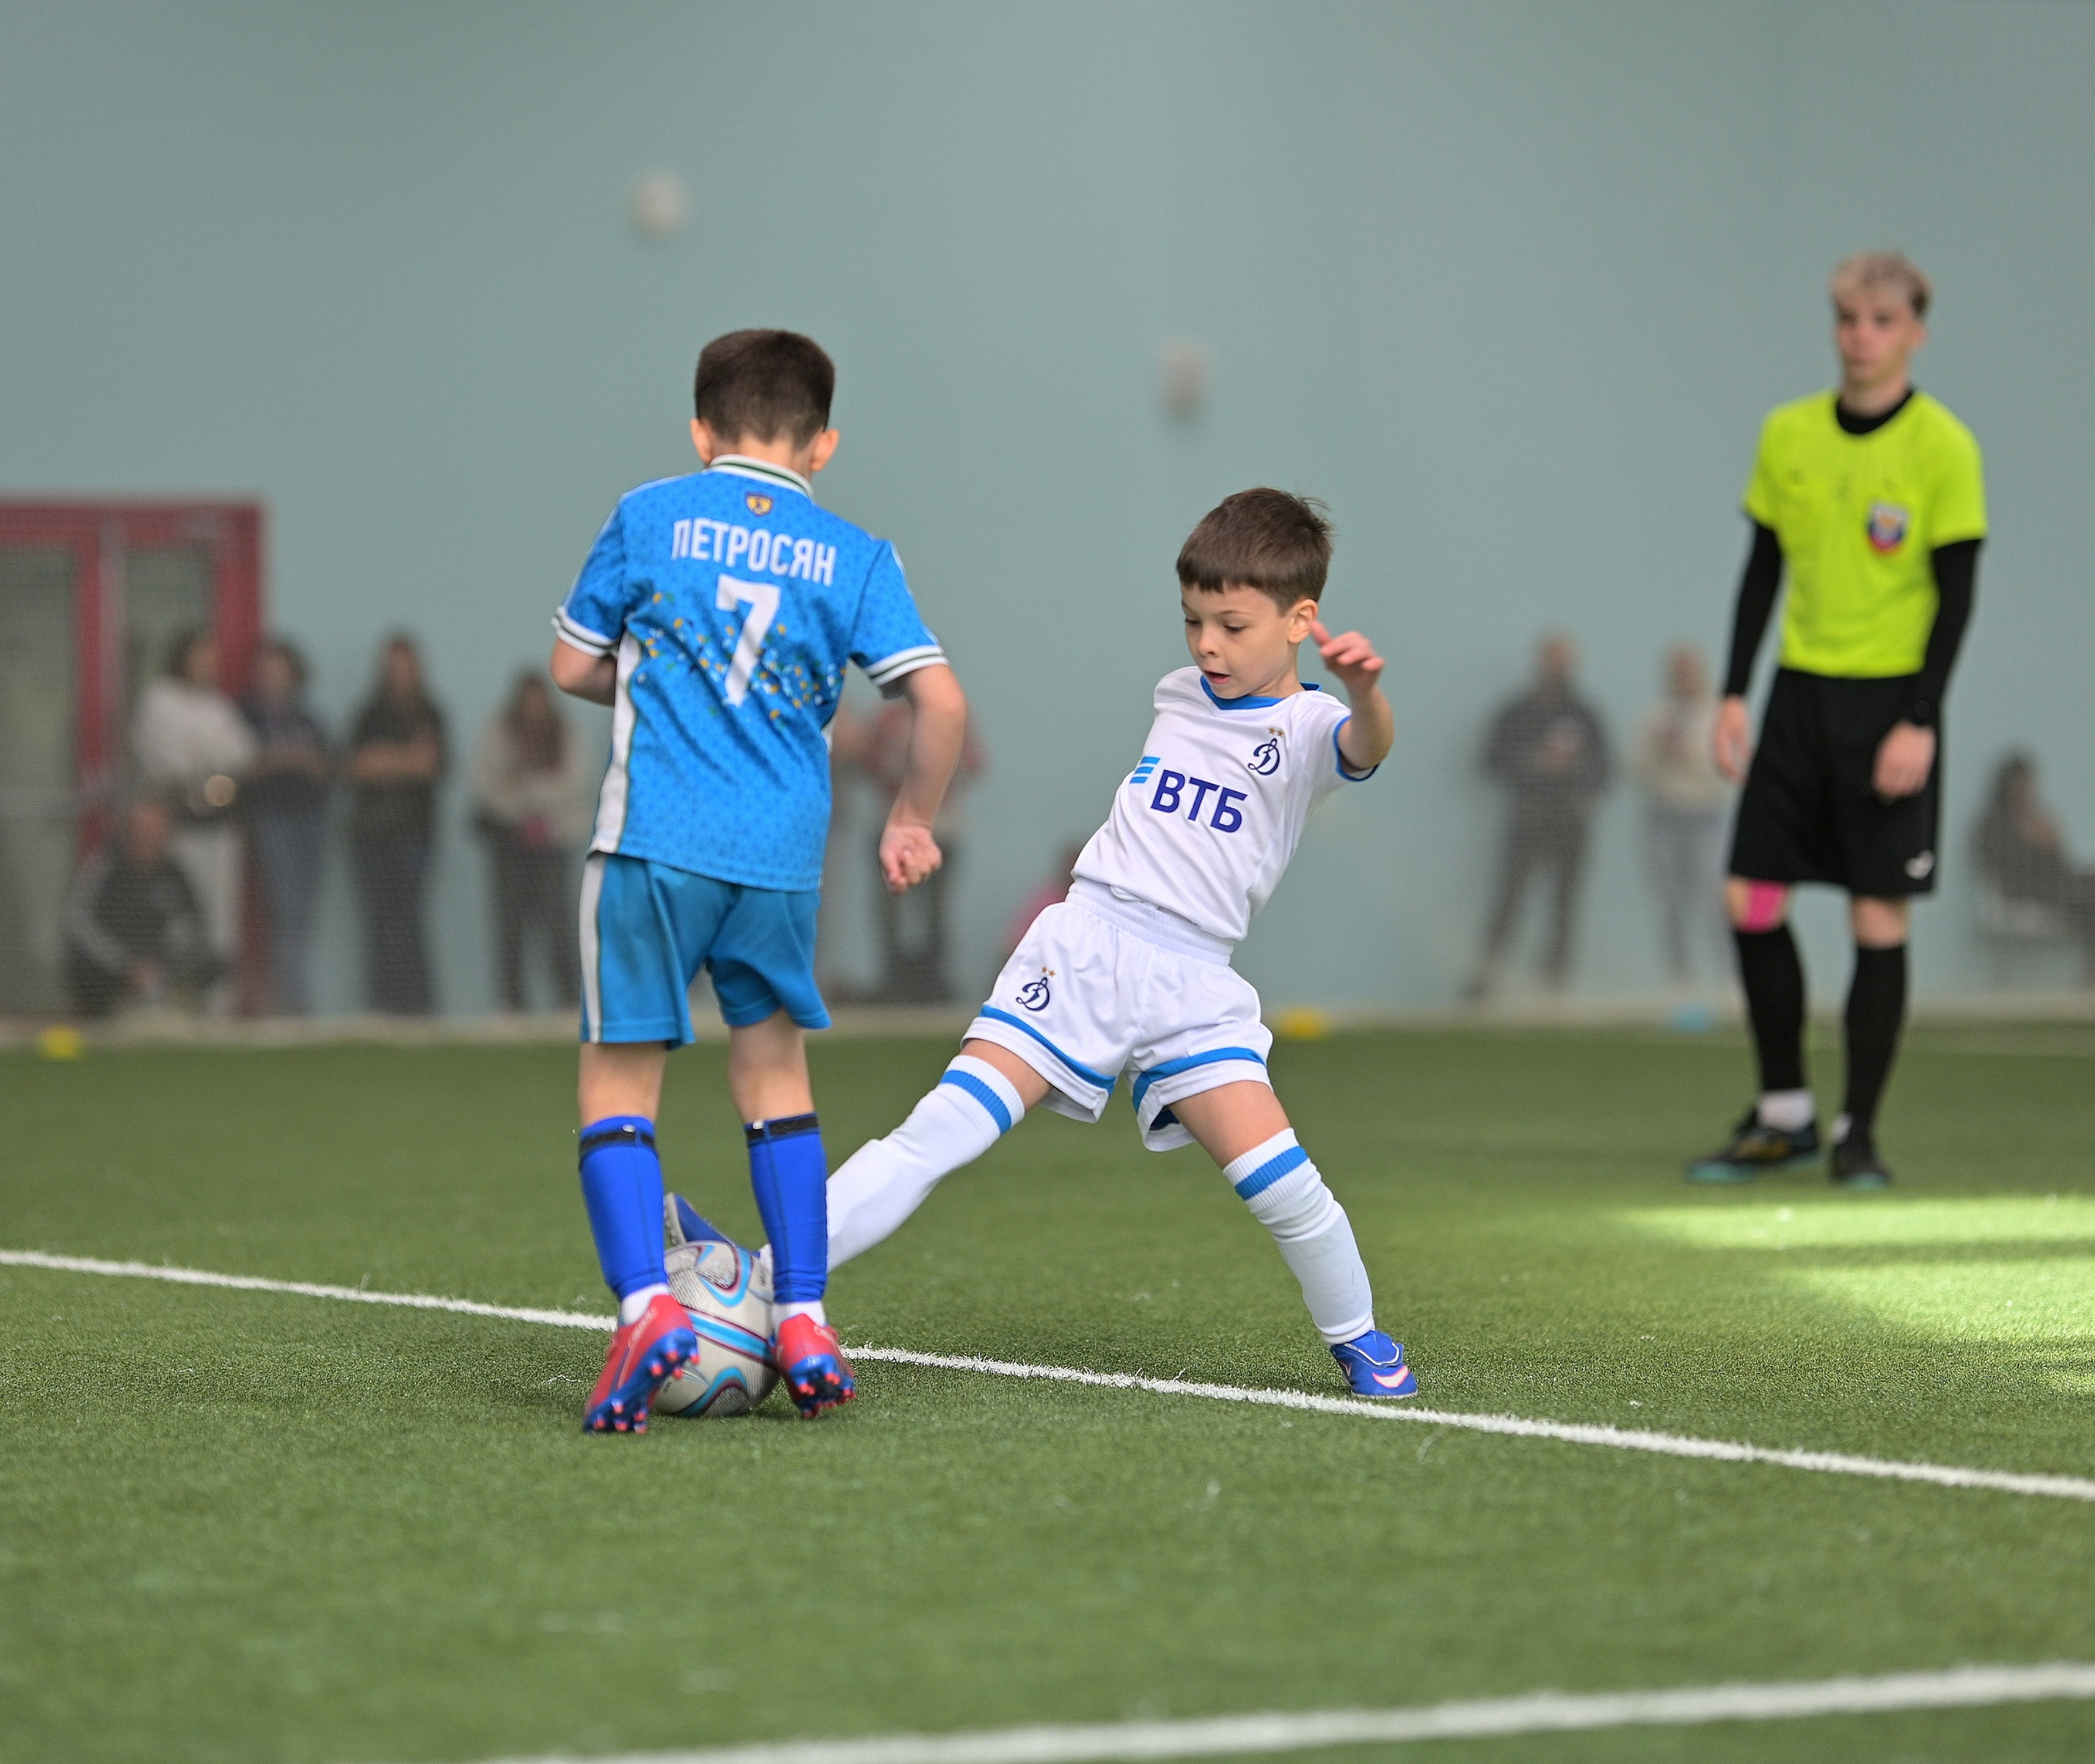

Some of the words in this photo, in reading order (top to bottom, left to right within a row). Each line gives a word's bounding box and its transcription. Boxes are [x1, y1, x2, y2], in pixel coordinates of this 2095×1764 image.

[670, 517, 837, 587] ПЕТРОСЯН
[715, 573, 781, 707] 7
[1150, 769, 1248, 833] ВТБ
